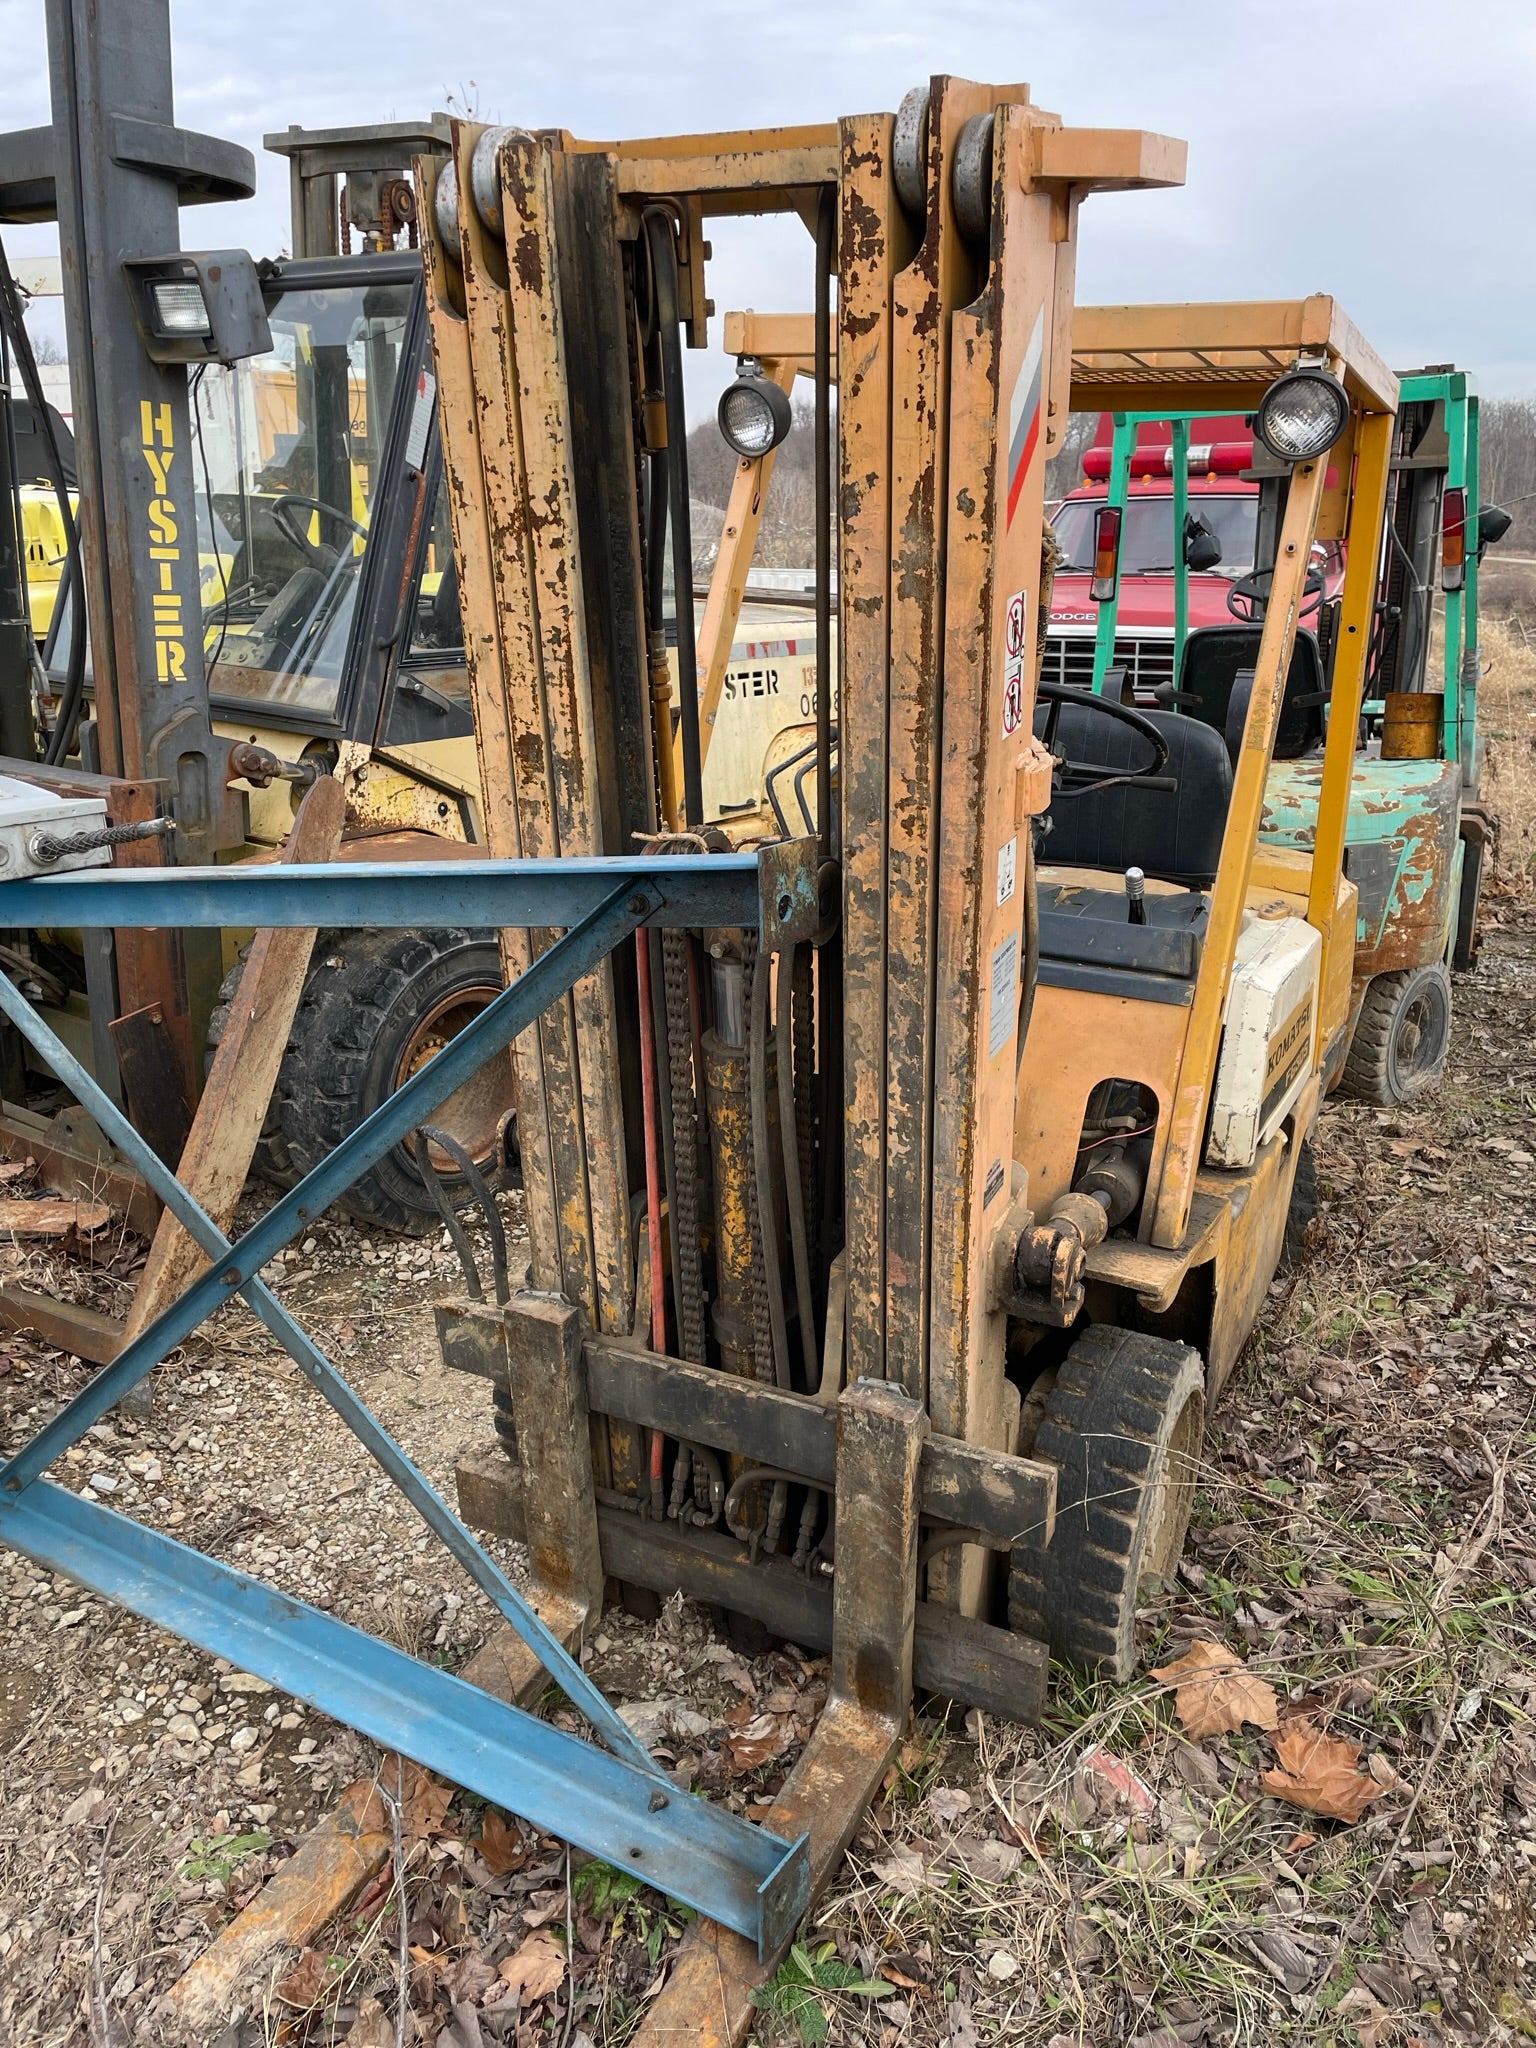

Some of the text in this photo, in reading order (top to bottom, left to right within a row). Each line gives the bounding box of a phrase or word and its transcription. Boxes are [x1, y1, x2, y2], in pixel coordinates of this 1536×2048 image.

[140, 400, 188, 682] HYSTER
[1048, 612, 1097, 621] ODGE
[724, 669, 779, 701] STER
[1267, 1003, 1312, 1078] KOMATSU
